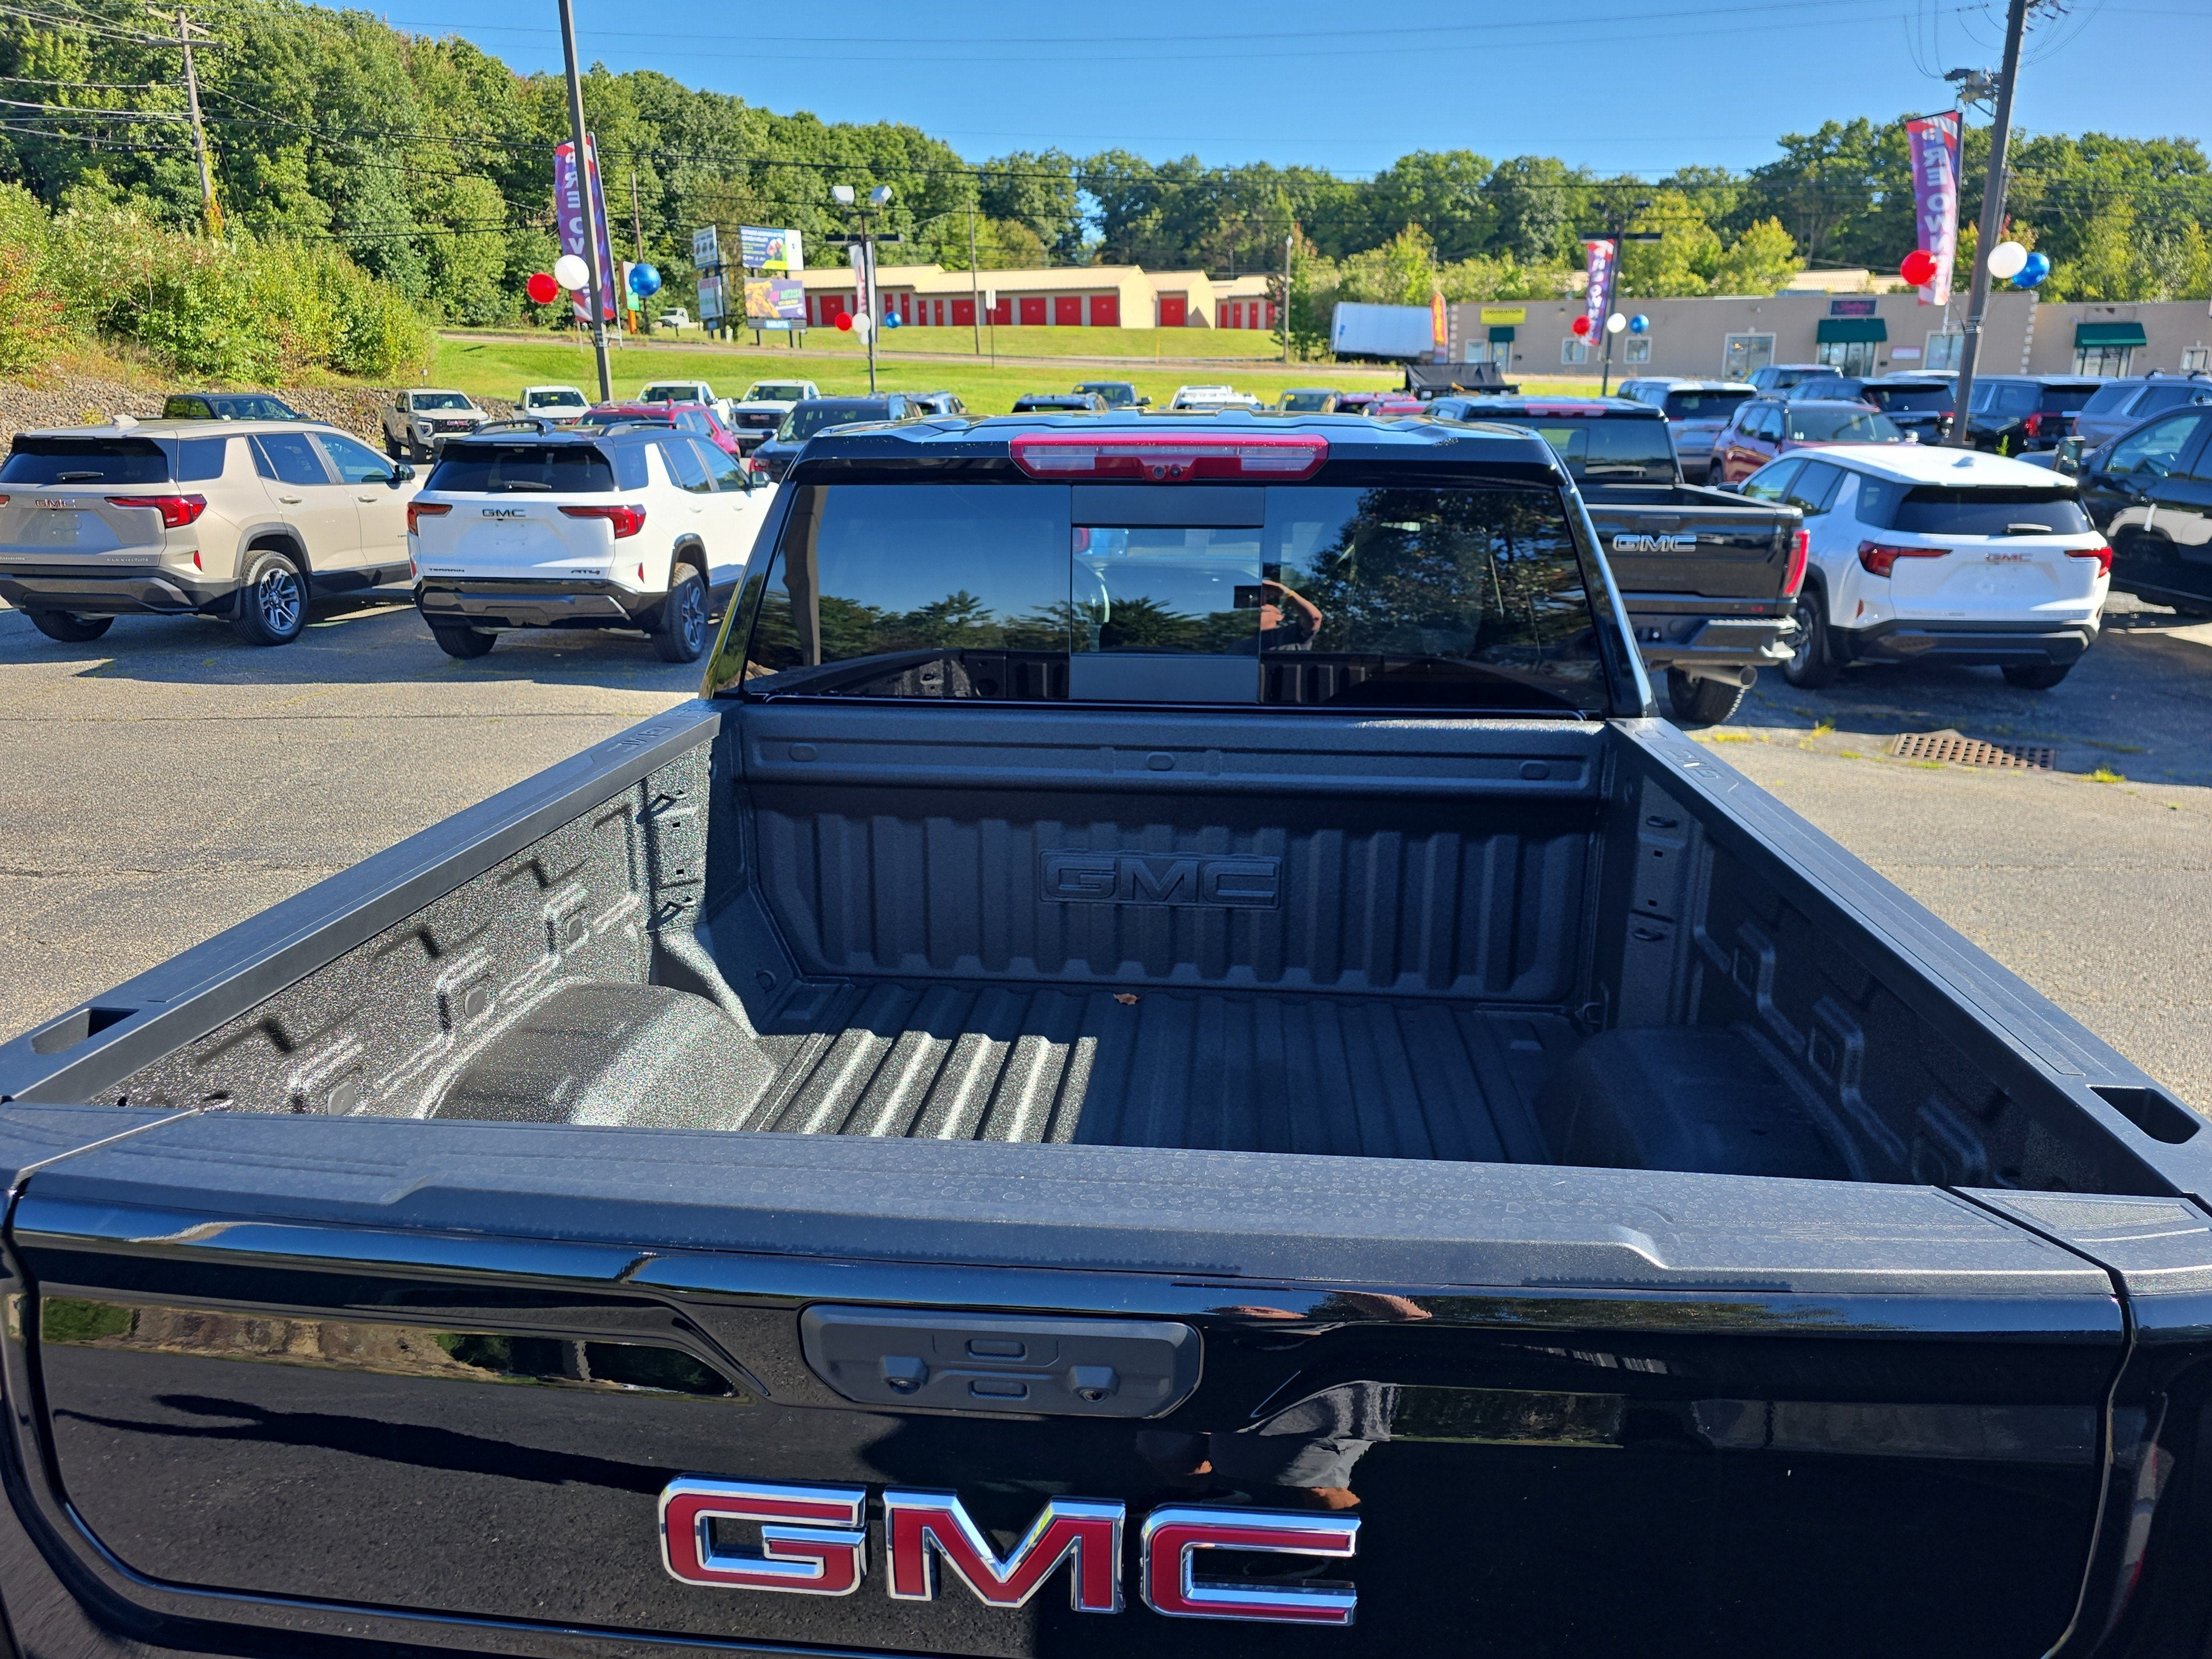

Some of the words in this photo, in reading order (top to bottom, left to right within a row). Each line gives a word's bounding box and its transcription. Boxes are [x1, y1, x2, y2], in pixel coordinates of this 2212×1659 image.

[35, 499, 76, 508] GMC
[482, 509, 526, 517] GMC
[1613, 534, 1697, 552] GMC
[1985, 552, 2033, 563] GMC
[1044, 855, 1277, 905] GMC
[659, 1474, 1361, 1626] GMC
